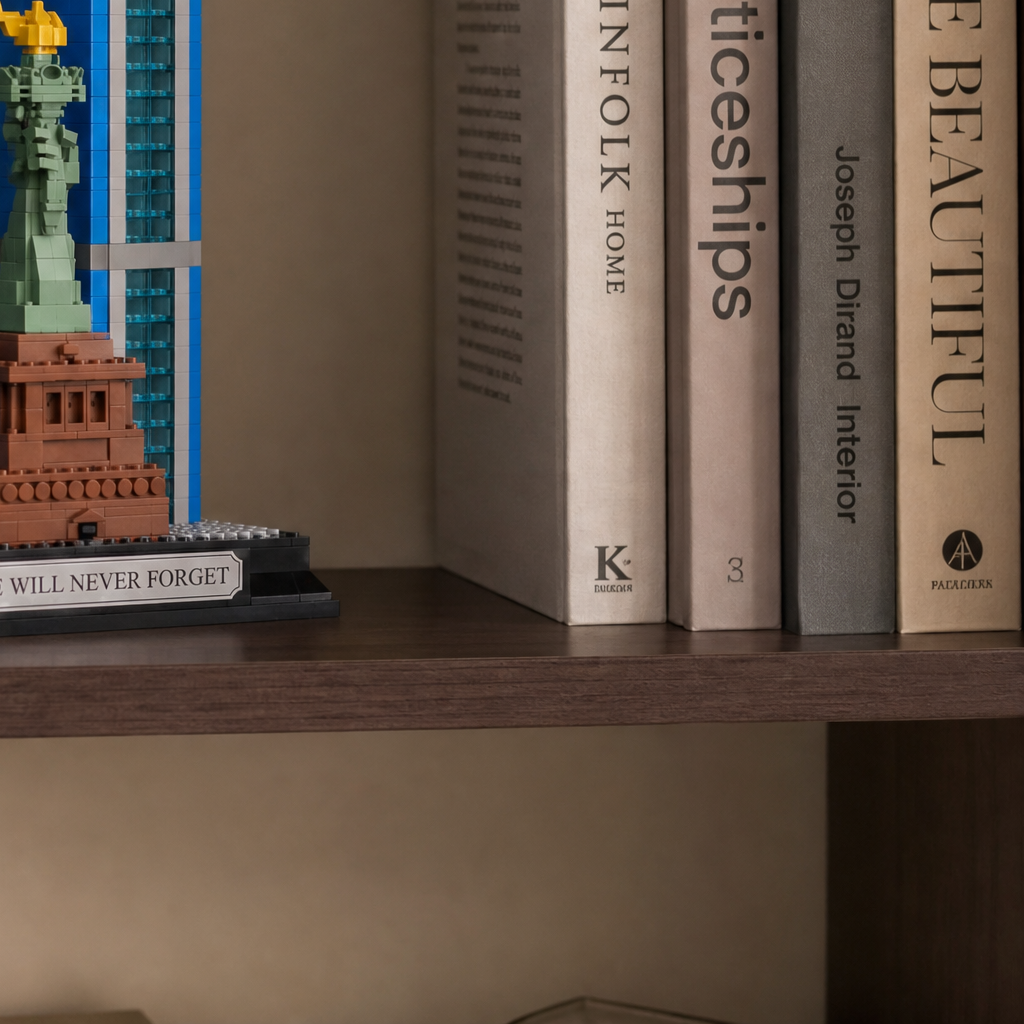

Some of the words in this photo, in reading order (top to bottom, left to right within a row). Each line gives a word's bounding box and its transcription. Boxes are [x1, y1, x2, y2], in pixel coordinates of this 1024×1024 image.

[605, 209, 626, 295] HOME
[829, 145, 861, 263] Joseph
[928, 54, 986, 467] BEAUTIFUL
[835, 278, 862, 381] Dirand
[836, 405, 862, 525] Interior
[9, 575, 65, 595] WILL
[69, 571, 142, 592] NEVER
[147, 566, 230, 589] FORGET
